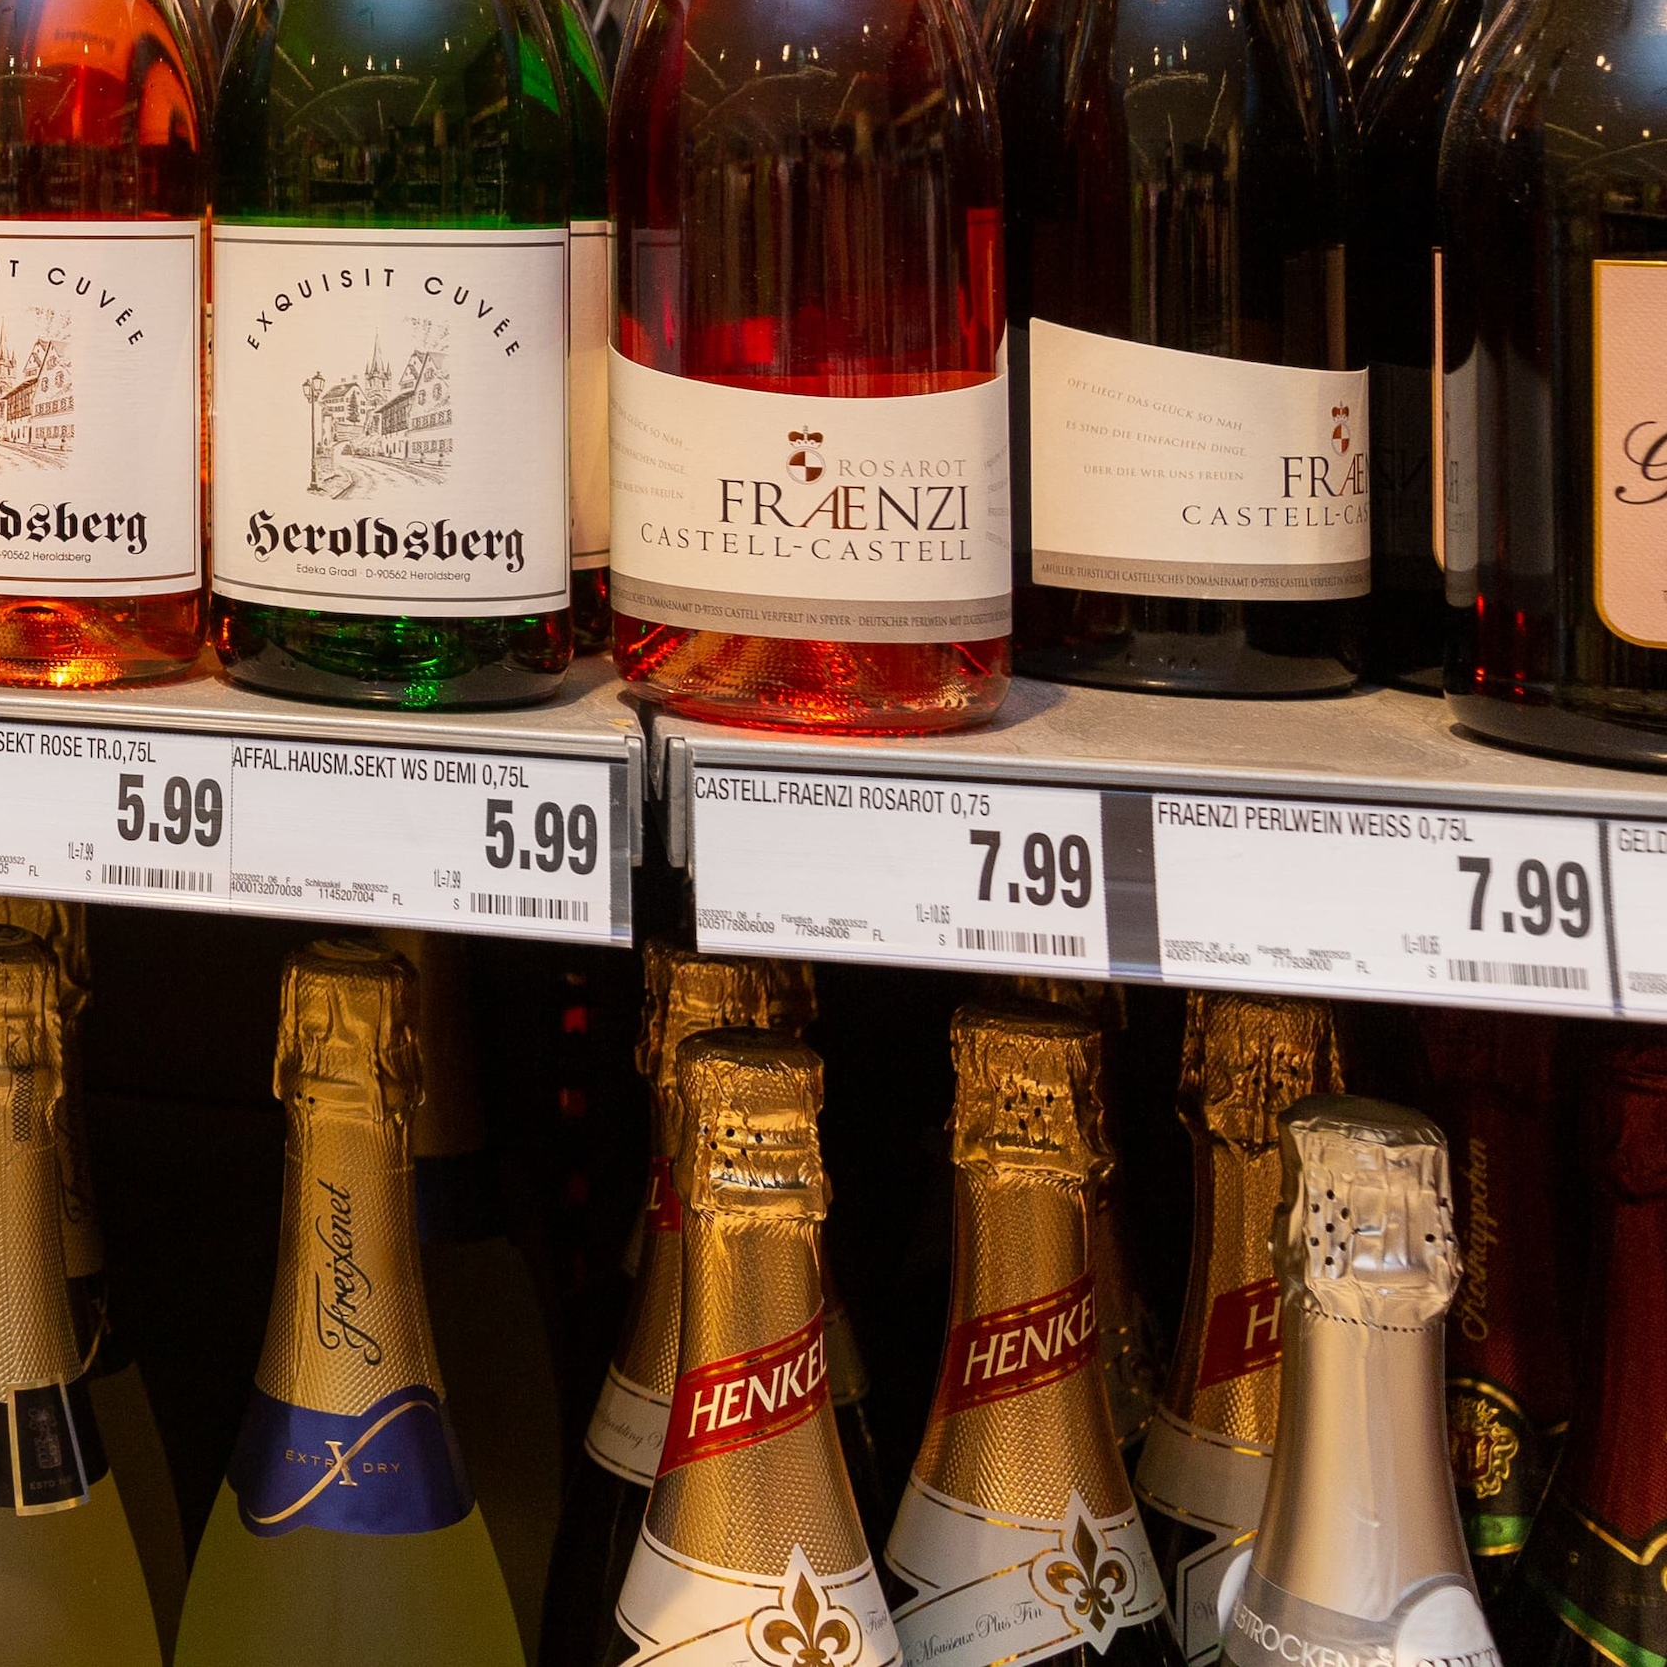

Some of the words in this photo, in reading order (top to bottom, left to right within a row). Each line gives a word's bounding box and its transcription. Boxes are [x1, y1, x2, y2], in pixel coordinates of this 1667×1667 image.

[46, 265, 144, 348] CUVÉE
[246, 268, 396, 352] EXQUISIT
[423, 275, 521, 359] CUVÉE
[838, 459, 968, 478] ROSAROT
[246, 509, 526, 574] Heroldsberg
[640, 521, 972, 563] CASTELL-CASTELL
[296, 563, 327, 575] Edeka
[329, 565, 359, 577] Gradl
[365, 568, 407, 580] D-90562
[409, 569, 471, 583] Heroldsberg
[40, 734, 83, 758] ROSE
[232, 745, 397, 780] AFFAL.HAUSM.SEKT
[400, 757, 428, 781] WS
[433, 760, 477, 785] DEMI
[481, 763, 529, 791] 0,75L
[116, 772, 224, 848] 5.99
[694, 775, 853, 810] CASTELL.FRAENZI
[859, 785, 947, 816] ROSAROT
[949, 791, 991, 819] 0,75
[1157, 800, 1239, 831] FRAENZI
[1244, 805, 1344, 837] PERLWEIN
[1347, 811, 1412, 840] WEISS
[1417, 814, 1475, 845] 0,75L
[67, 840, 95, 862] 1L=7.99
[484, 797, 599, 876] 5.99
[968, 828, 1092, 910] 7.99
[1457, 854, 1593, 940] 7.99
[315, 1177, 382, 1367] Freixenet
[687, 1332, 827, 1439] HENKEL
[362, 1459, 403, 1476] DRY
